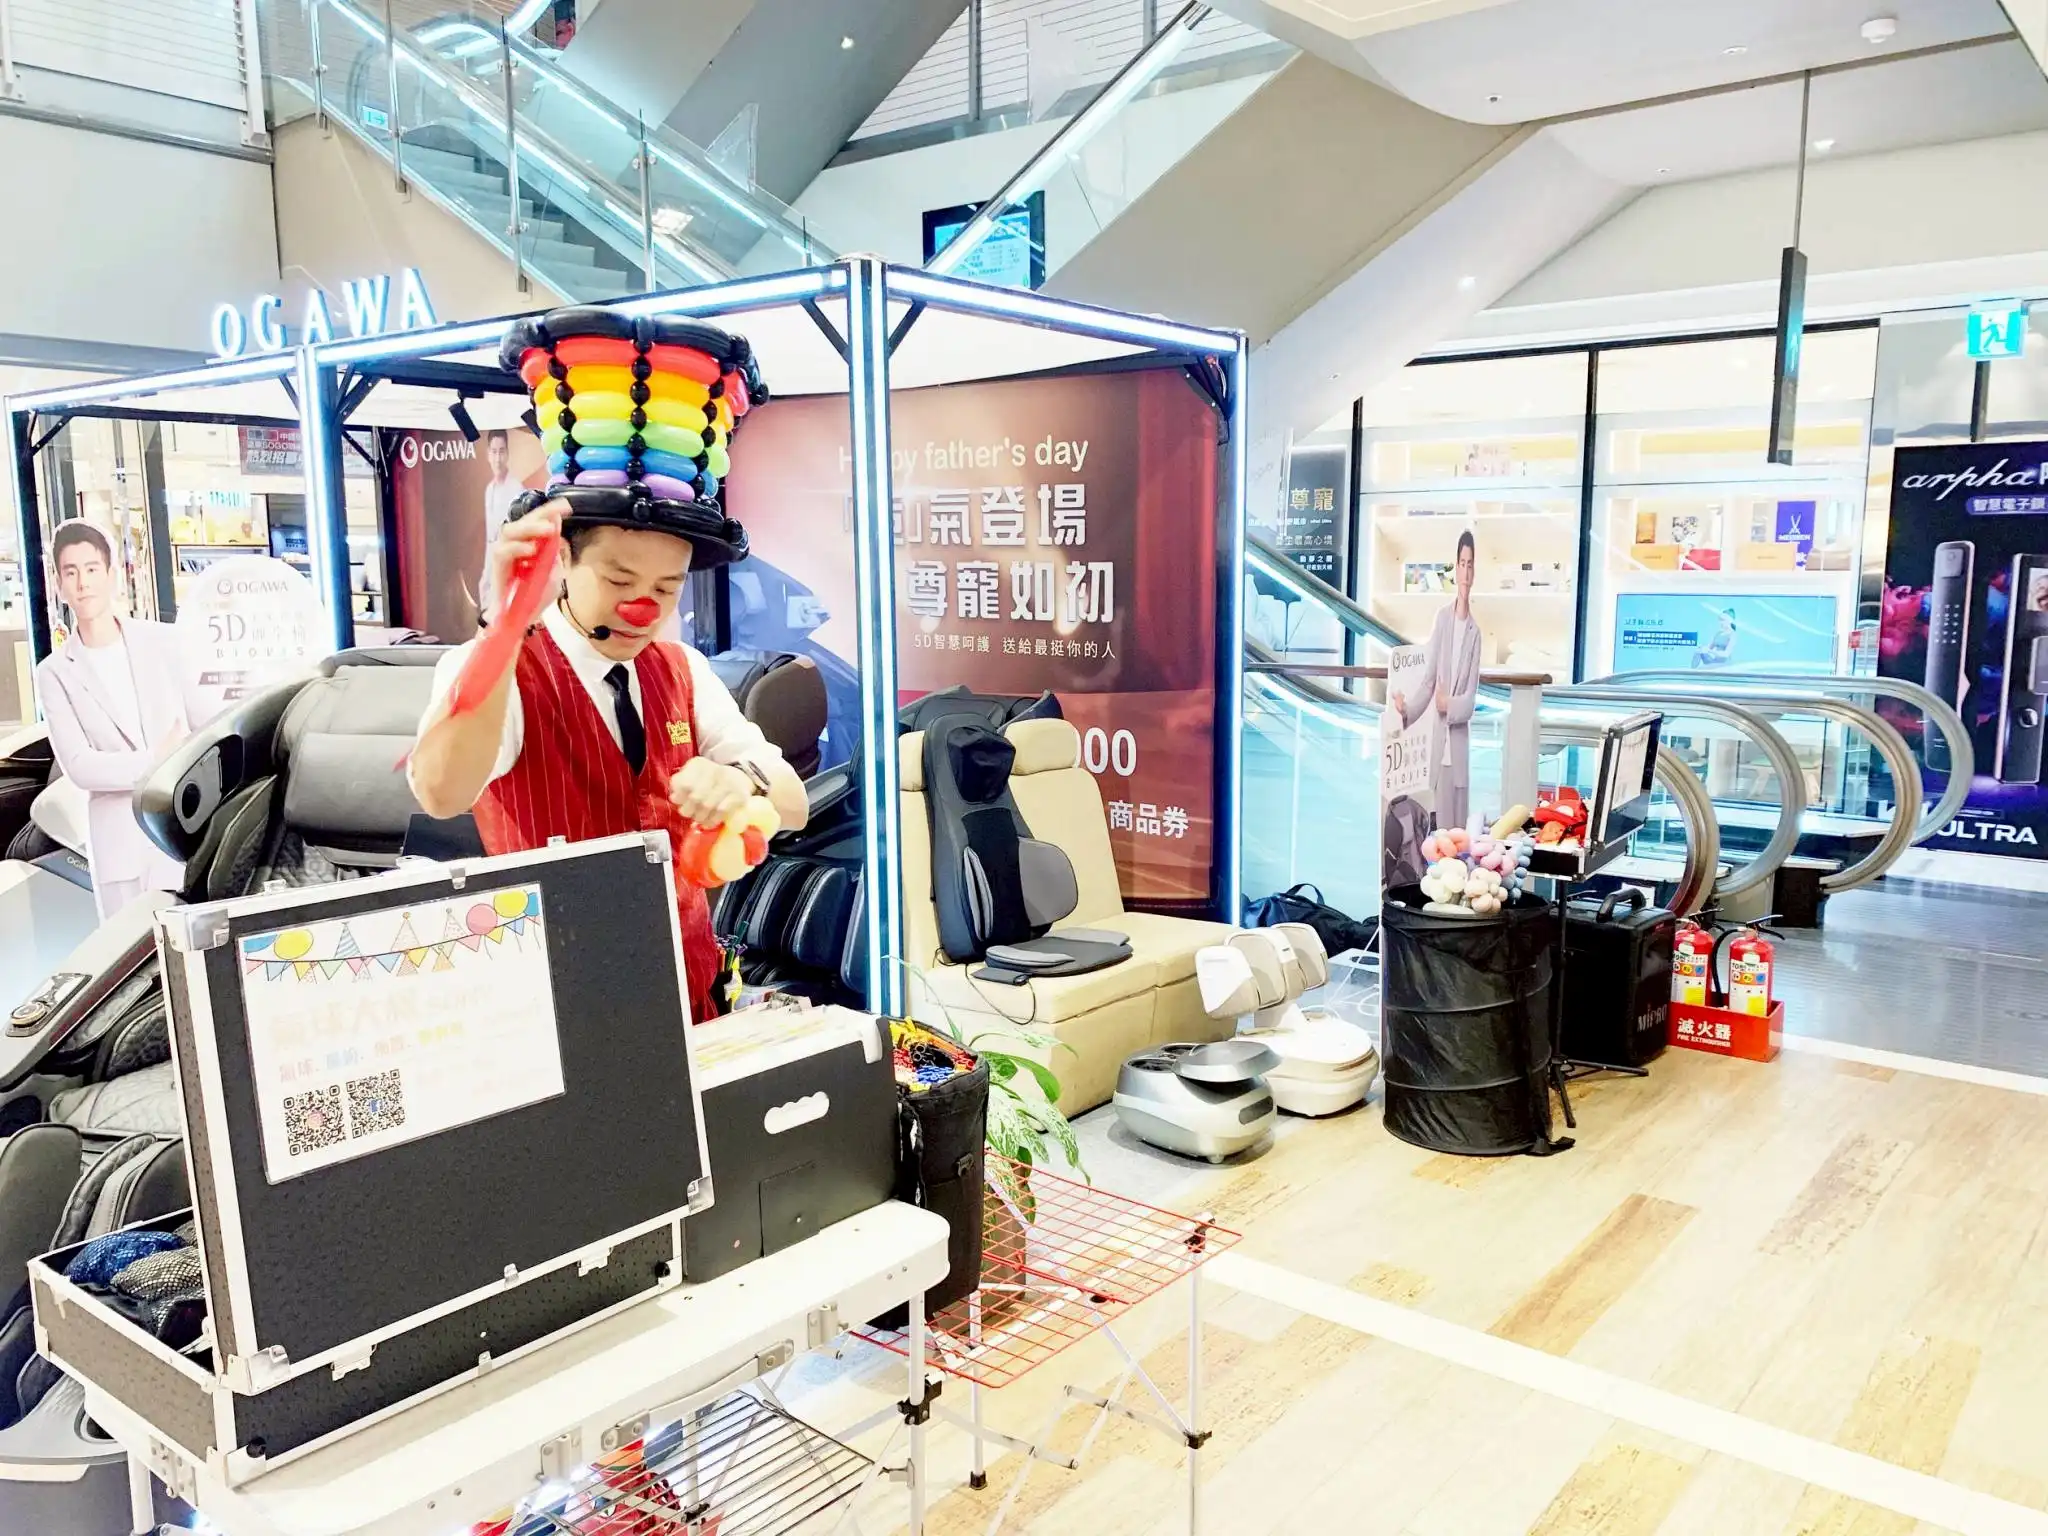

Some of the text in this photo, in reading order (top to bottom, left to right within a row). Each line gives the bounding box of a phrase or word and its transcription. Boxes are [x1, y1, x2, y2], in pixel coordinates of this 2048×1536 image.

[211, 267, 437, 359] OGAWA
[421, 440, 476, 462] OGAWA
[839, 435, 1088, 480] Hpy father's day
[237, 580, 289, 595] OGAWA
[906, 560, 1114, 624] 尊寵如初
[208, 612, 247, 644] 5D
[913, 633, 1116, 660] 5D智慧呵護 送給最挺你的人
[1386, 742, 1403, 776] 5D
[1107, 800, 1189, 839] 商品券
[1677, 1017, 1732, 1041] 滅火器
